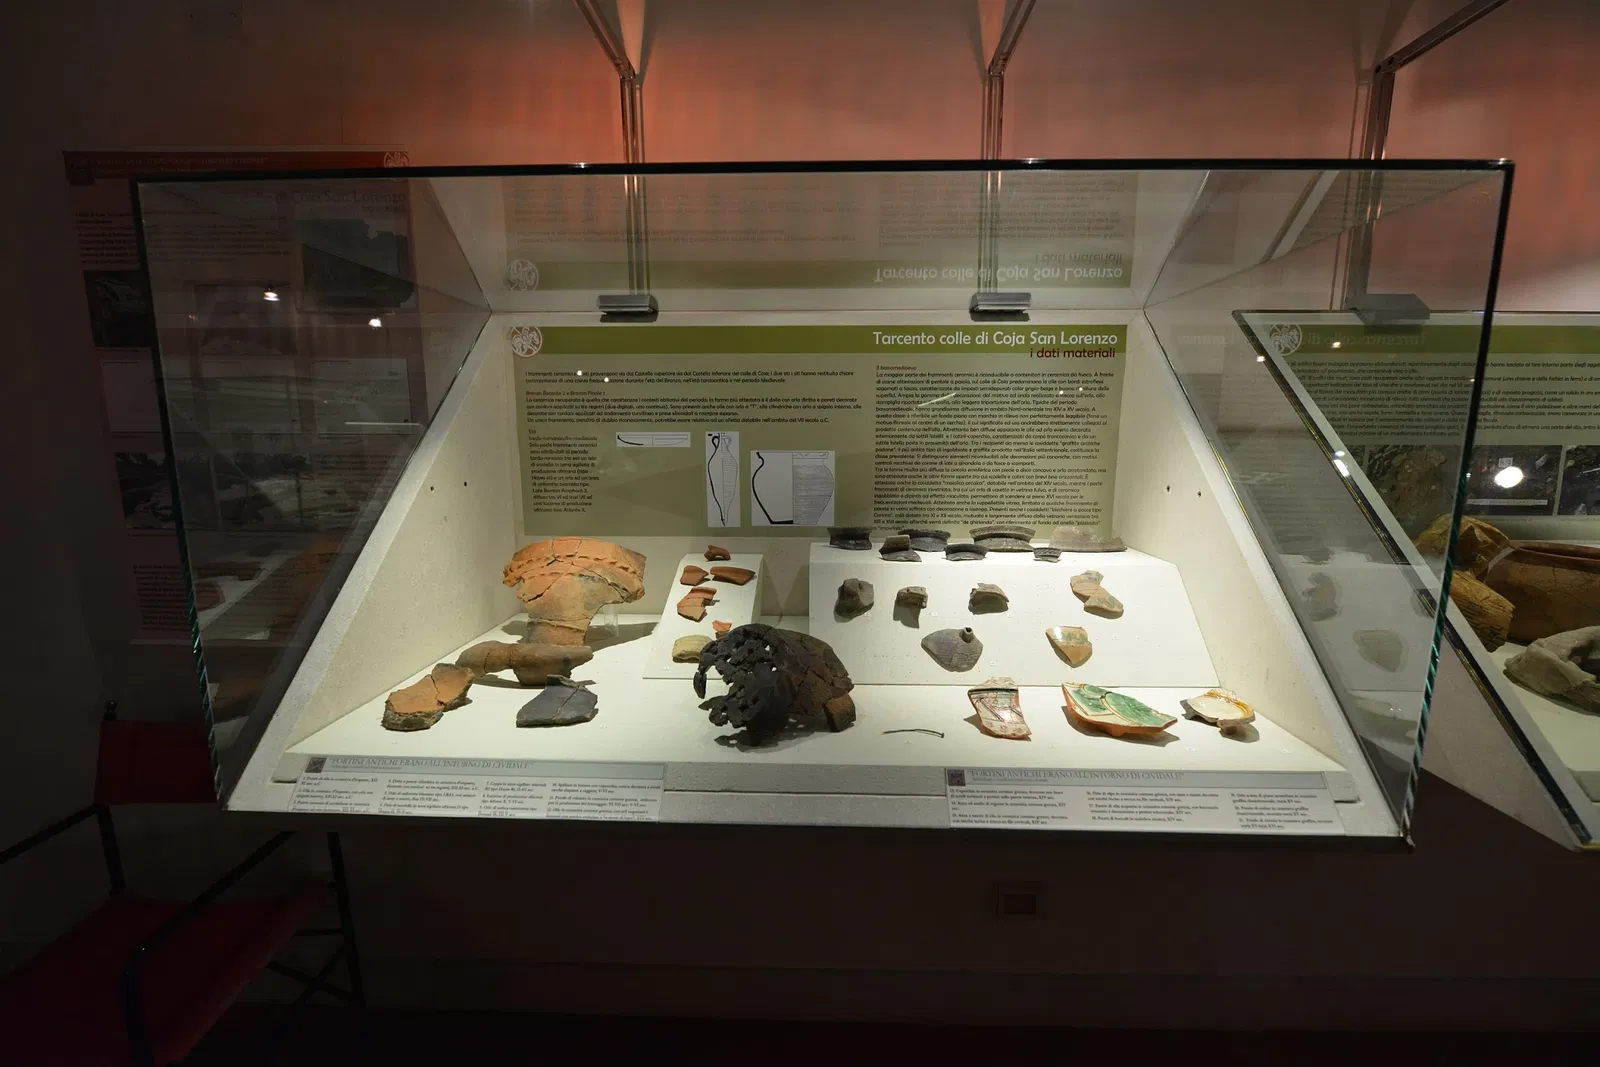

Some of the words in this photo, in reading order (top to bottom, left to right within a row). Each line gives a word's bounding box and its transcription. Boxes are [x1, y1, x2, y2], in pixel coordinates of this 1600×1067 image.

[873, 332, 936, 345] Tarcento
[940, 331, 971, 345] colle
[976, 331, 988, 345] di
[993, 332, 1025, 348] Coja
[1030, 332, 1056, 345] San
[1061, 332, 1117, 345] Lorenzo
[1030, 348, 1033, 358] i
[1037, 348, 1060, 358] dati
[1063, 348, 1115, 358] materiali
